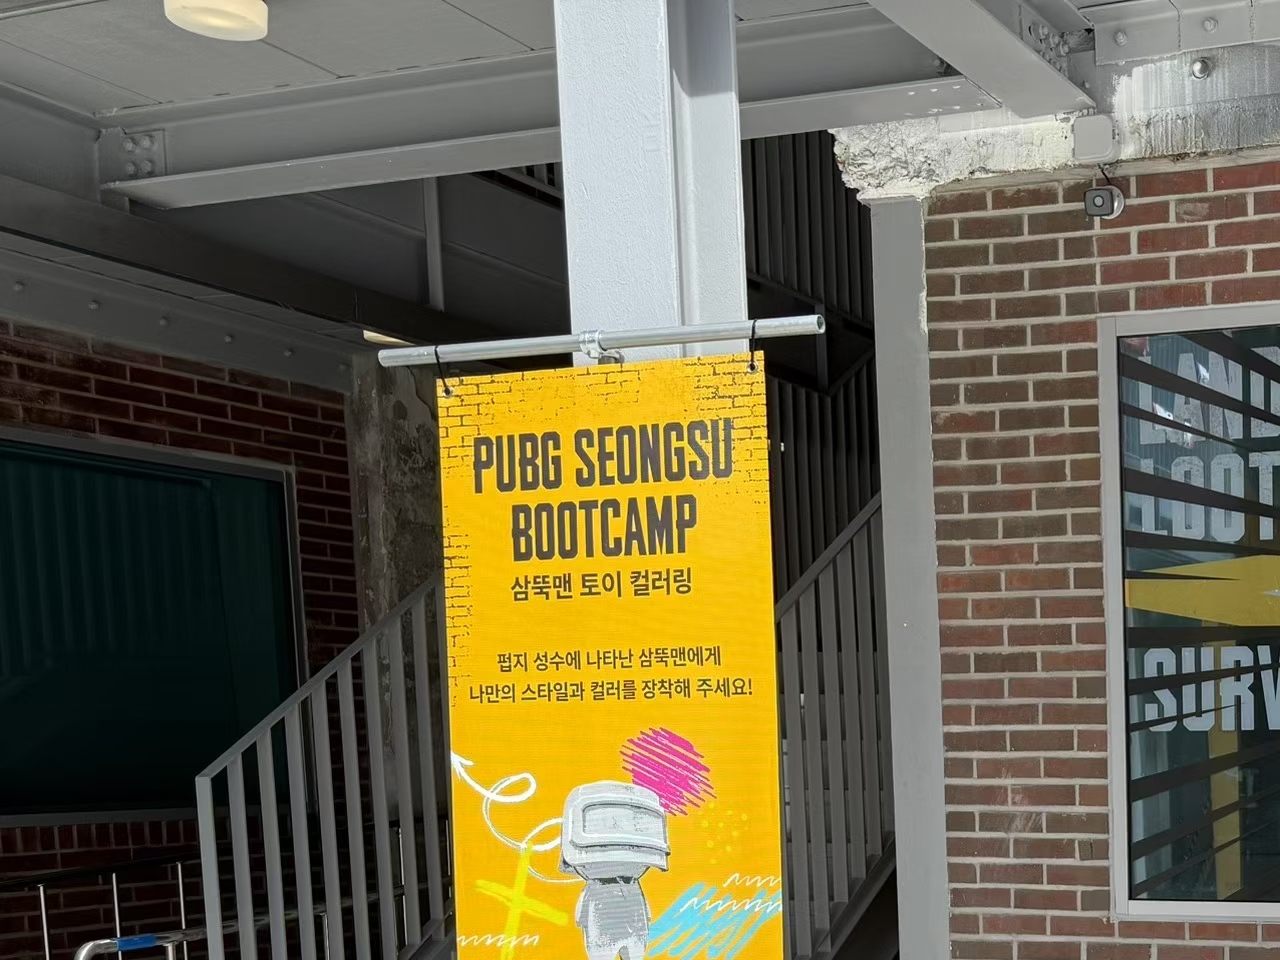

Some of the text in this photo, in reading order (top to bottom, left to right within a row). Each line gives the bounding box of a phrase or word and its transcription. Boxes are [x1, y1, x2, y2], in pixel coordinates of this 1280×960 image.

[473, 417, 733, 493] PUBG SEONGSU
[512, 495, 696, 561] BOOTCAMP
[511, 568, 691, 601] 삼뚝맨 토이 컬러링
[498, 646, 721, 672] 펍지 성수에 나타난 삼뚝맨에게
[470, 678, 752, 703] 나만의 스타일과 컬러를 장착해 주세요!
